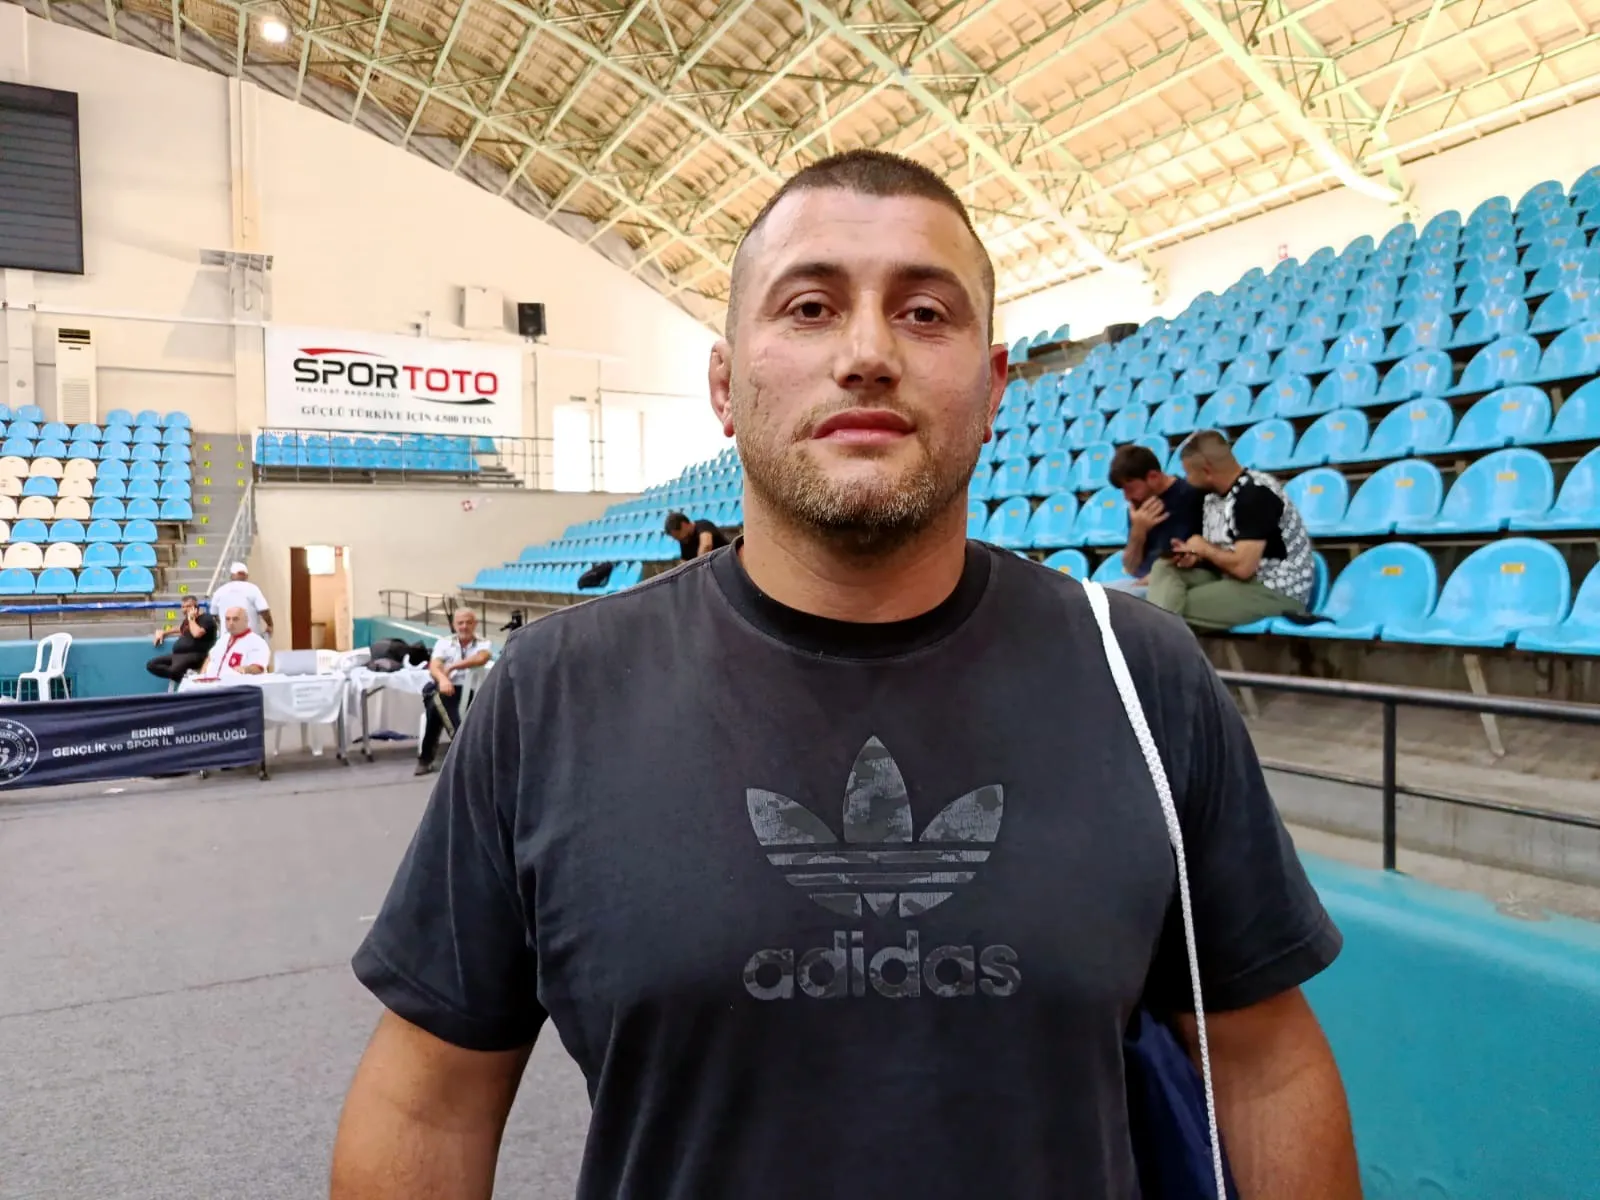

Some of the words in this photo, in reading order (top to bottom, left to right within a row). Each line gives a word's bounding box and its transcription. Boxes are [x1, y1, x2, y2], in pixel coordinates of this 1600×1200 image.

[301, 405, 345, 417] GÜÇLÜ
[349, 406, 402, 420] TÜRKİYE
[52, 742, 107, 757] GENÇLİK
[110, 743, 123, 751] ve
[126, 739, 160, 750] SPOR
[162, 736, 172, 746] İL
[175, 728, 247, 745] MÜDÜRLÜĞÜ
[131, 726, 175, 739] EDİRNE
[743, 930, 1022, 1000] adidas
